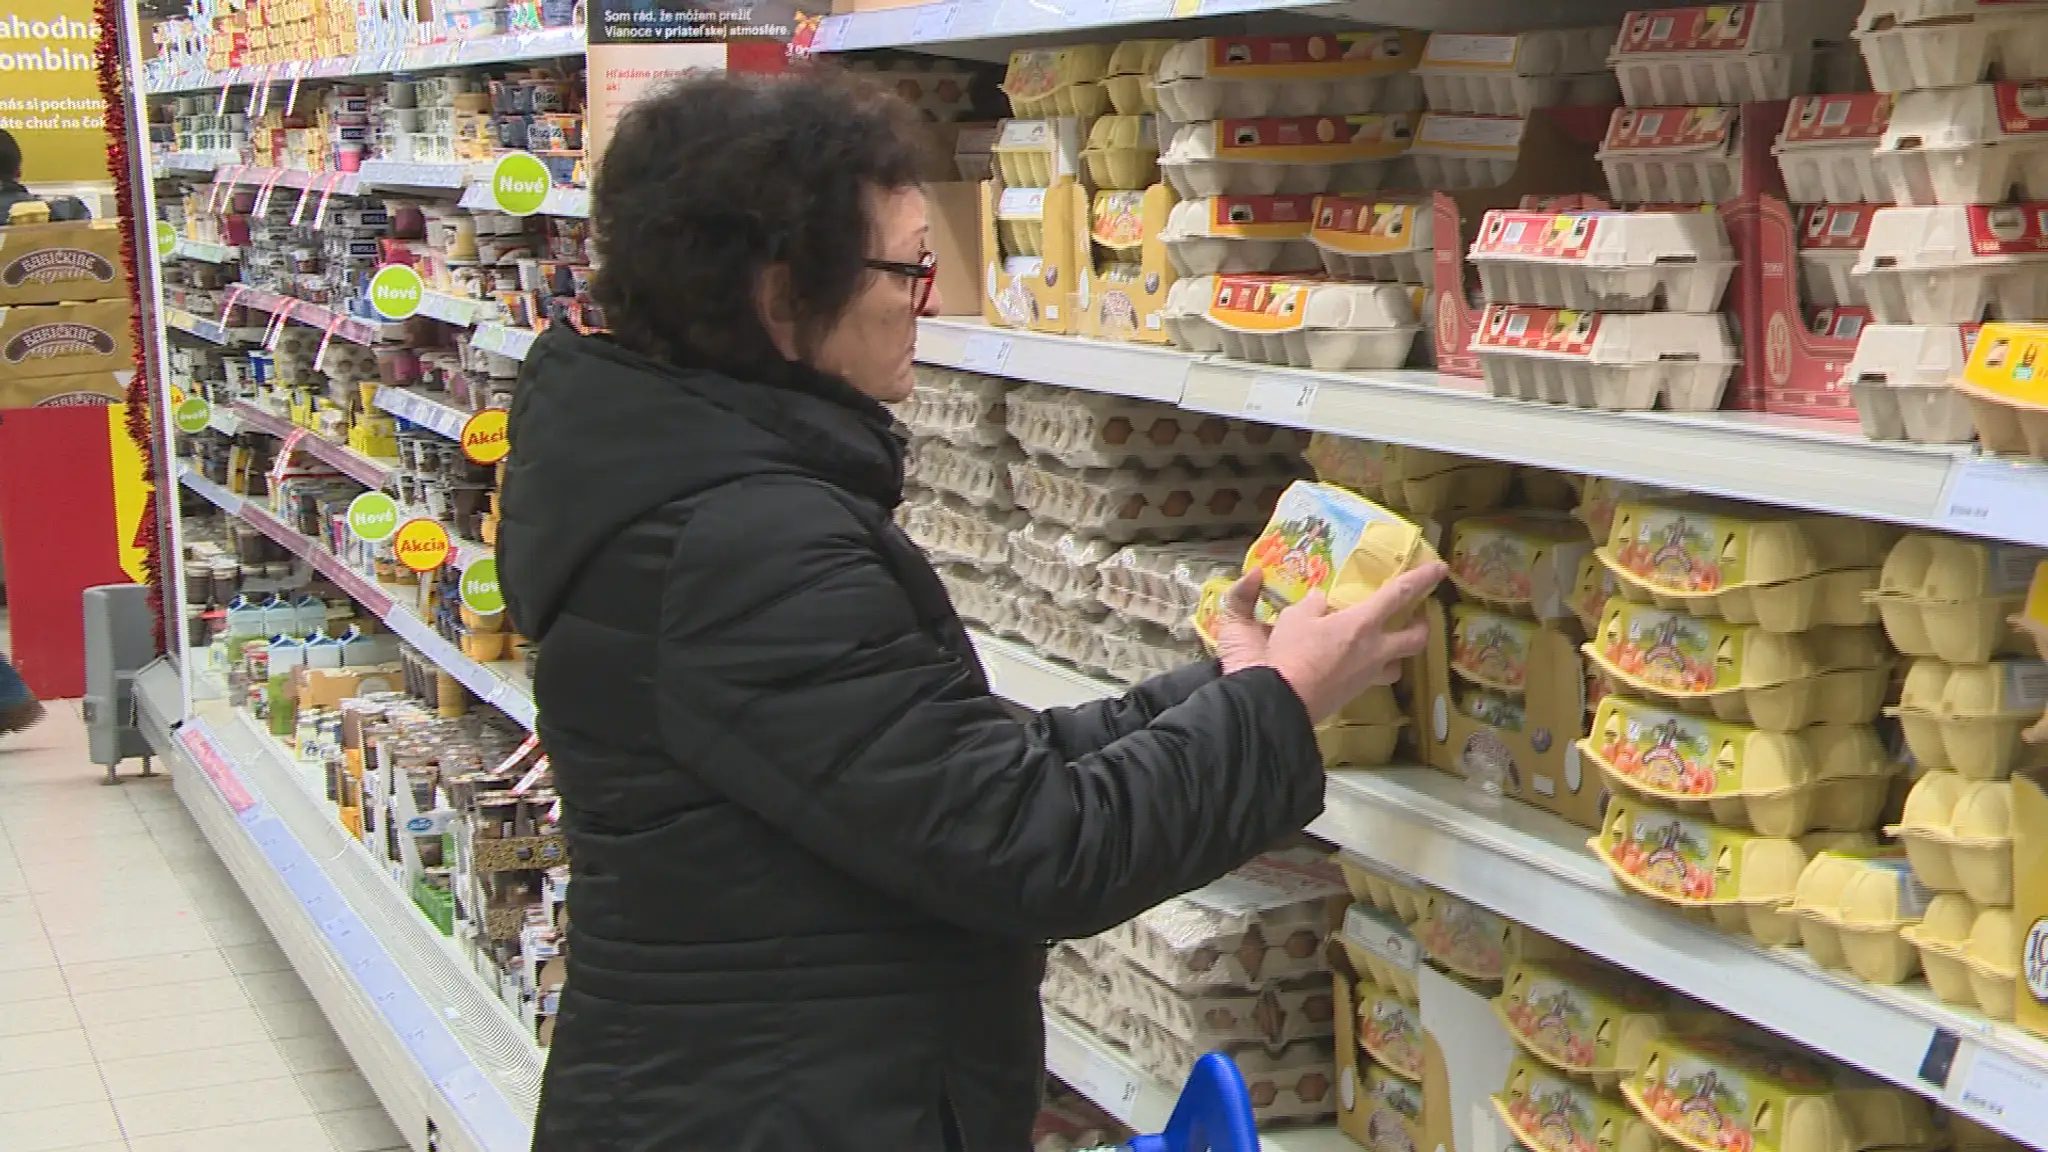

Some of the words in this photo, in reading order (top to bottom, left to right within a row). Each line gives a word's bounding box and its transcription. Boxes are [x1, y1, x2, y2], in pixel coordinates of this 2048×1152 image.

[605, 9, 631, 22] Som
[633, 10, 656, 22] rád,
[660, 9, 673, 22] že
[675, 9, 716, 22] môžem
[605, 25, 652, 37] Vianoce
[655, 27, 662, 37] v
[665, 25, 727, 40] priateľskej
[730, 24, 790, 35] atmosfére.
[500, 176, 544, 194] Nové
[377, 285, 417, 299] Nové
[467, 427, 506, 446] Akci
[354, 510, 393, 527] Nové
[400, 538, 445, 553] Akcia
[467, 579, 500, 595] Nov
